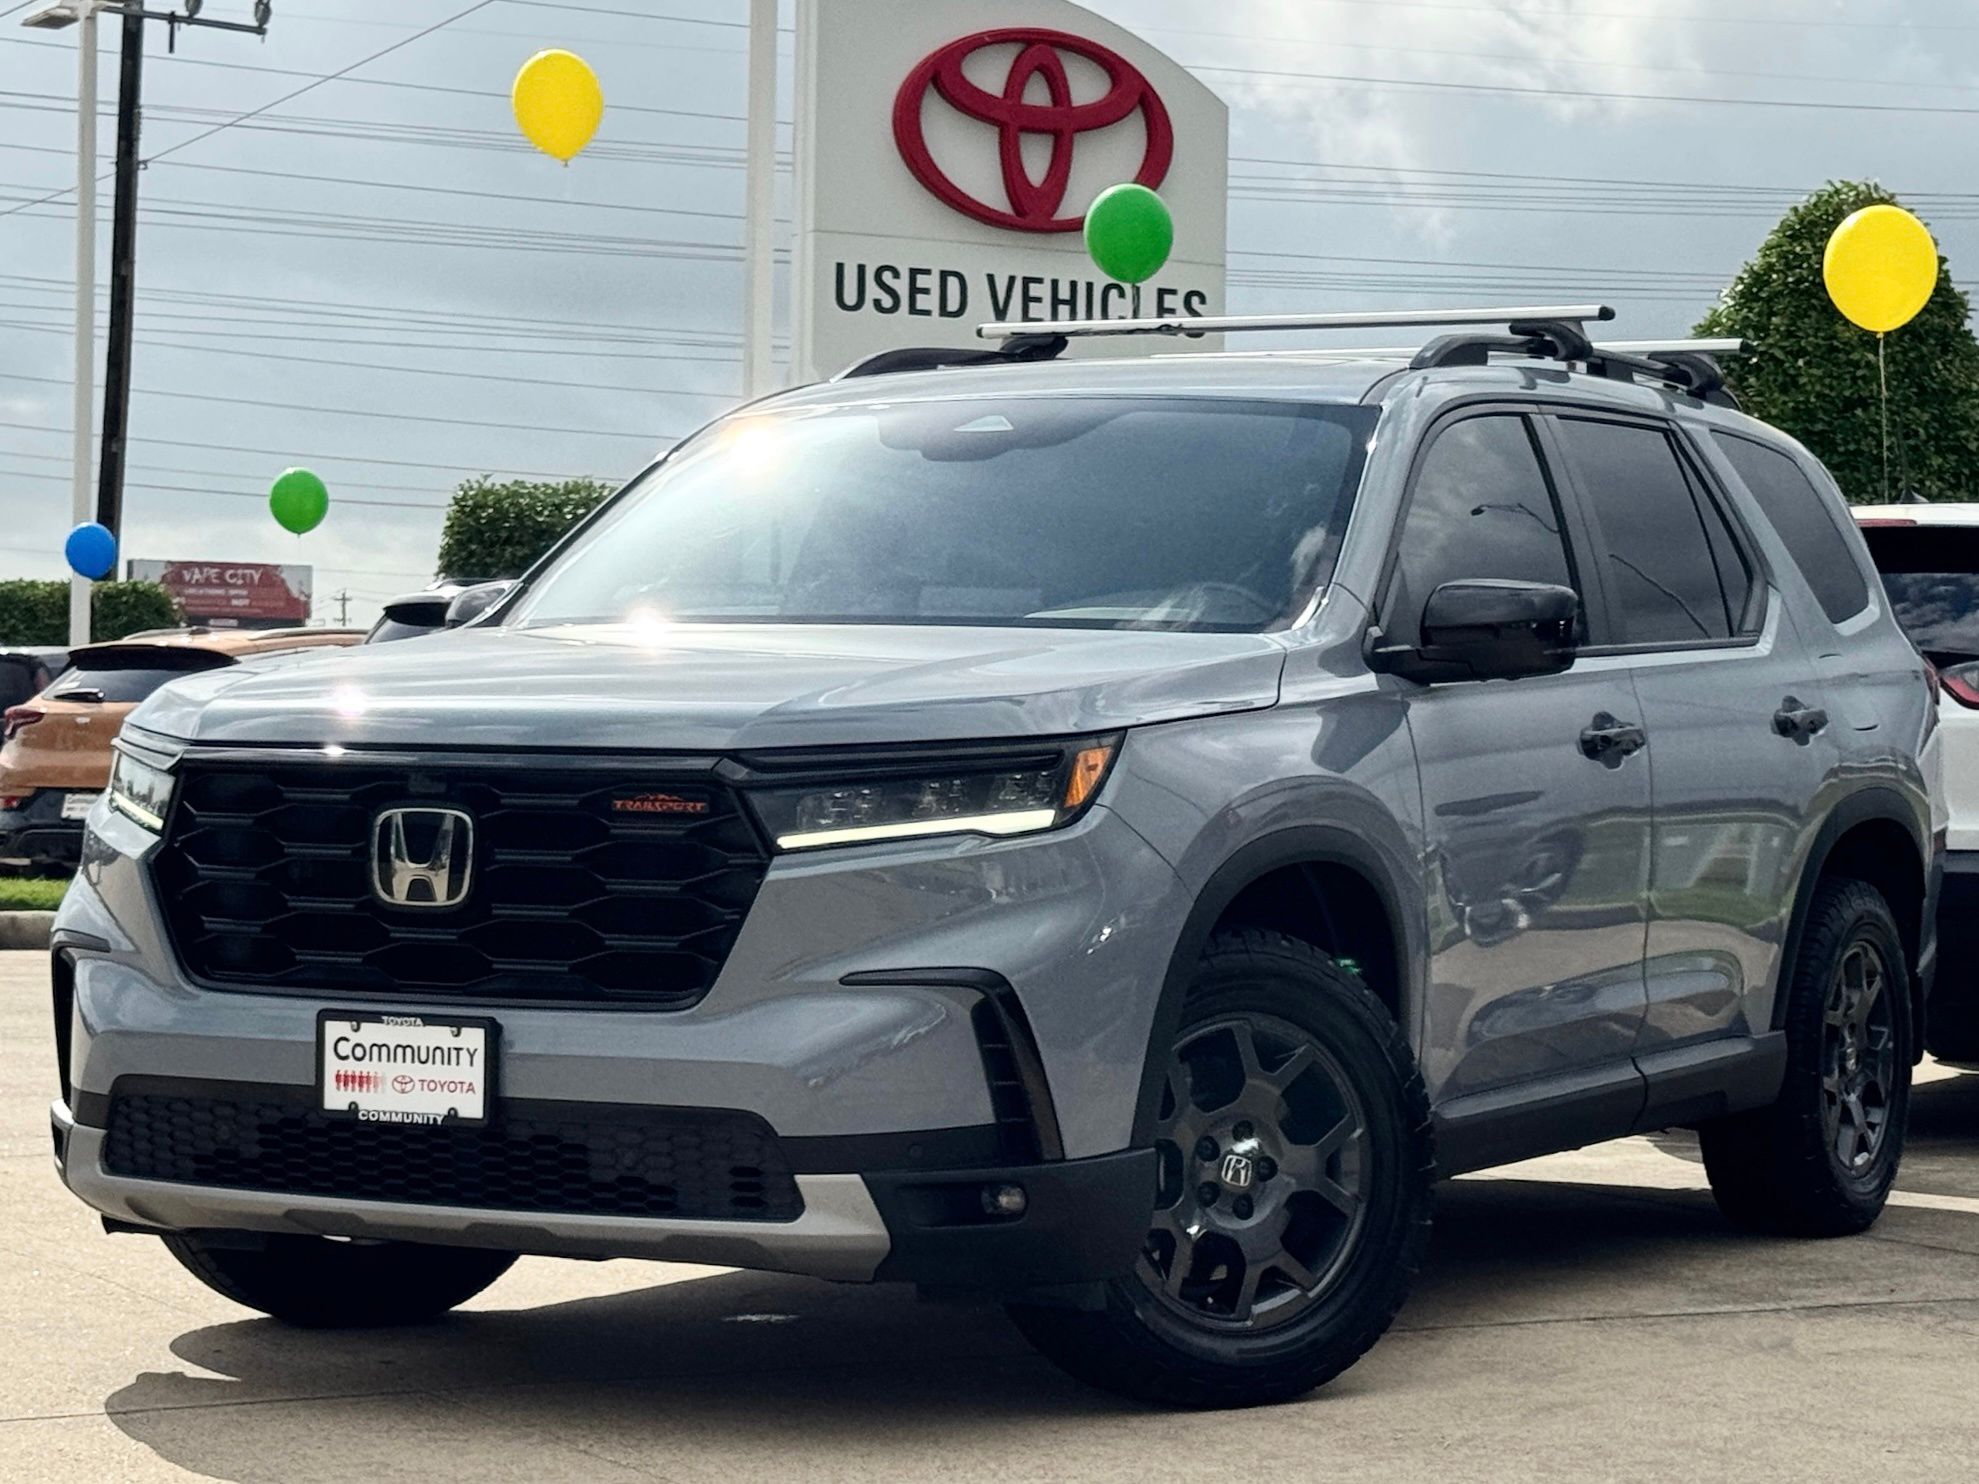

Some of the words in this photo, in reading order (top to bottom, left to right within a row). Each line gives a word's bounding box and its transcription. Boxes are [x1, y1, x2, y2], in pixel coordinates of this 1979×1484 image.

[835, 262, 968, 318] USED
[182, 566, 221, 585] VAPE
[224, 567, 263, 585] CITY
[381, 1015, 425, 1027] TOYOTA
[418, 1079, 477, 1095] TOYOTA
[358, 1109, 446, 1126] COMMUNITY
